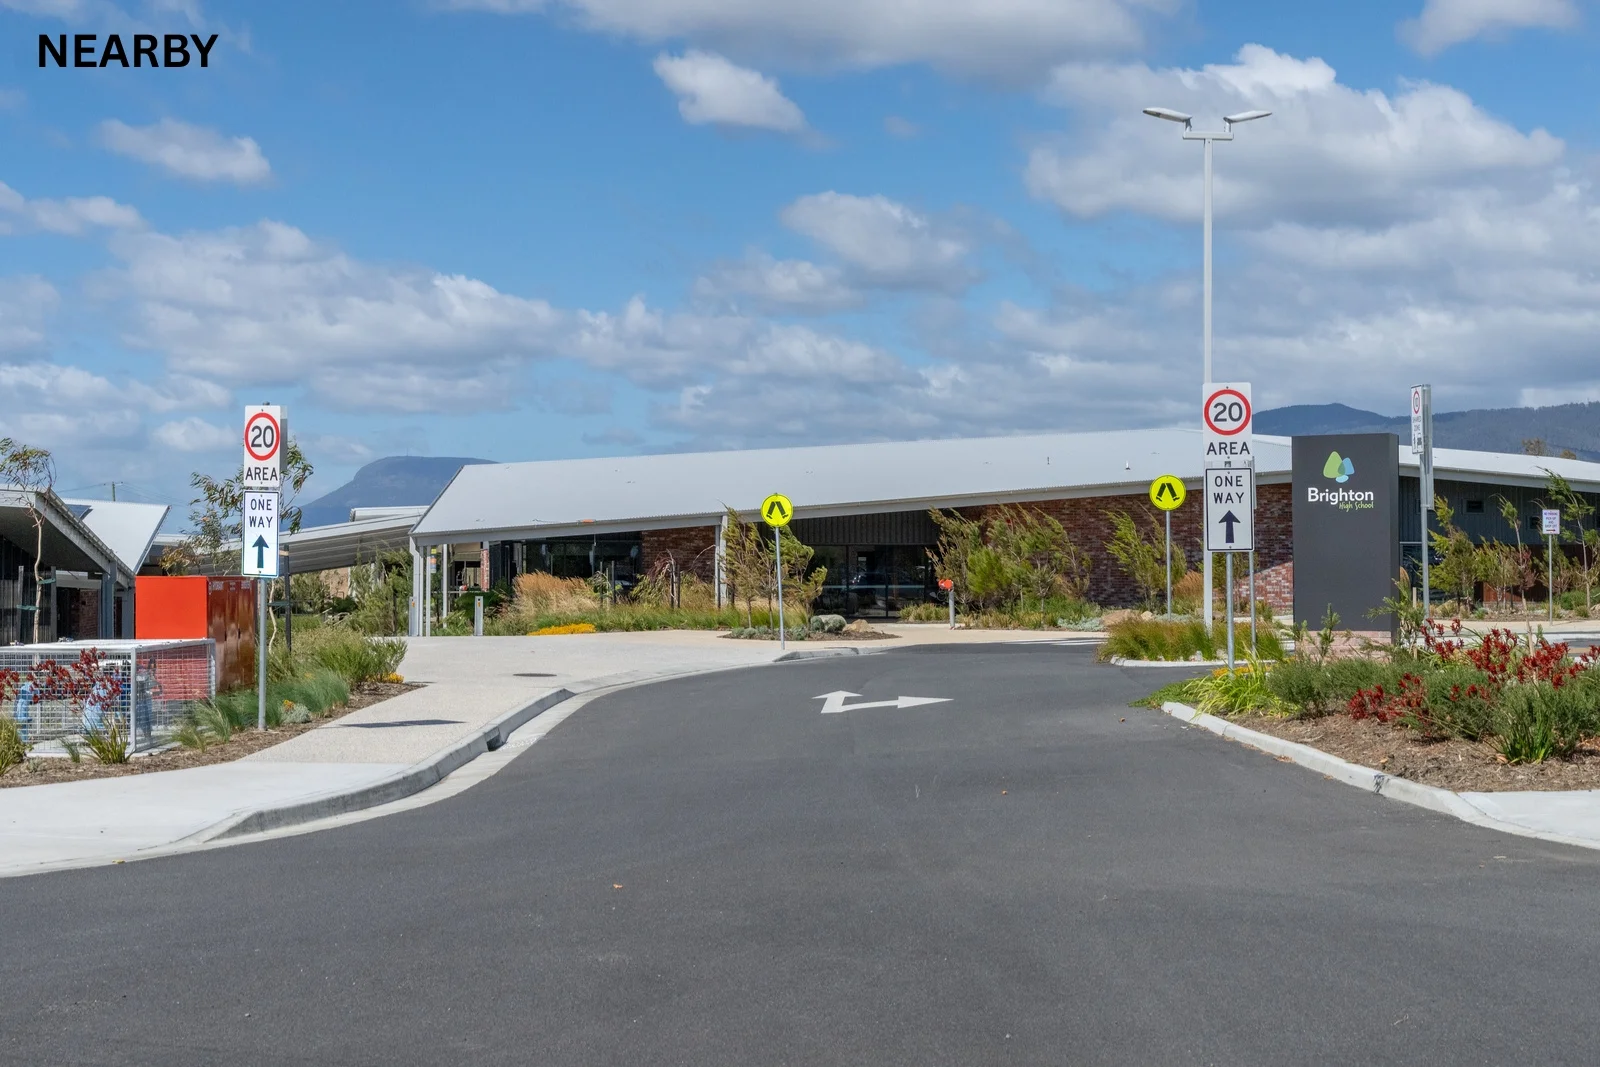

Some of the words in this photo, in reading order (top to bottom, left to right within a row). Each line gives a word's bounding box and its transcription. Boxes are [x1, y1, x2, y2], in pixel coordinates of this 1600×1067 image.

[1213, 402, 1243, 423] 20
[251, 425, 274, 448] 20
[1206, 441, 1251, 456] AREA
[245, 467, 278, 481] AREA
[1214, 475, 1243, 487] ONE
[1213, 492, 1245, 504] WAY
[1308, 487, 1374, 505] Brighton
[250, 498, 273, 511] ONE
[1339, 501, 1353, 512] High
[1354, 501, 1374, 511] School
[249, 516, 273, 528] WAY
